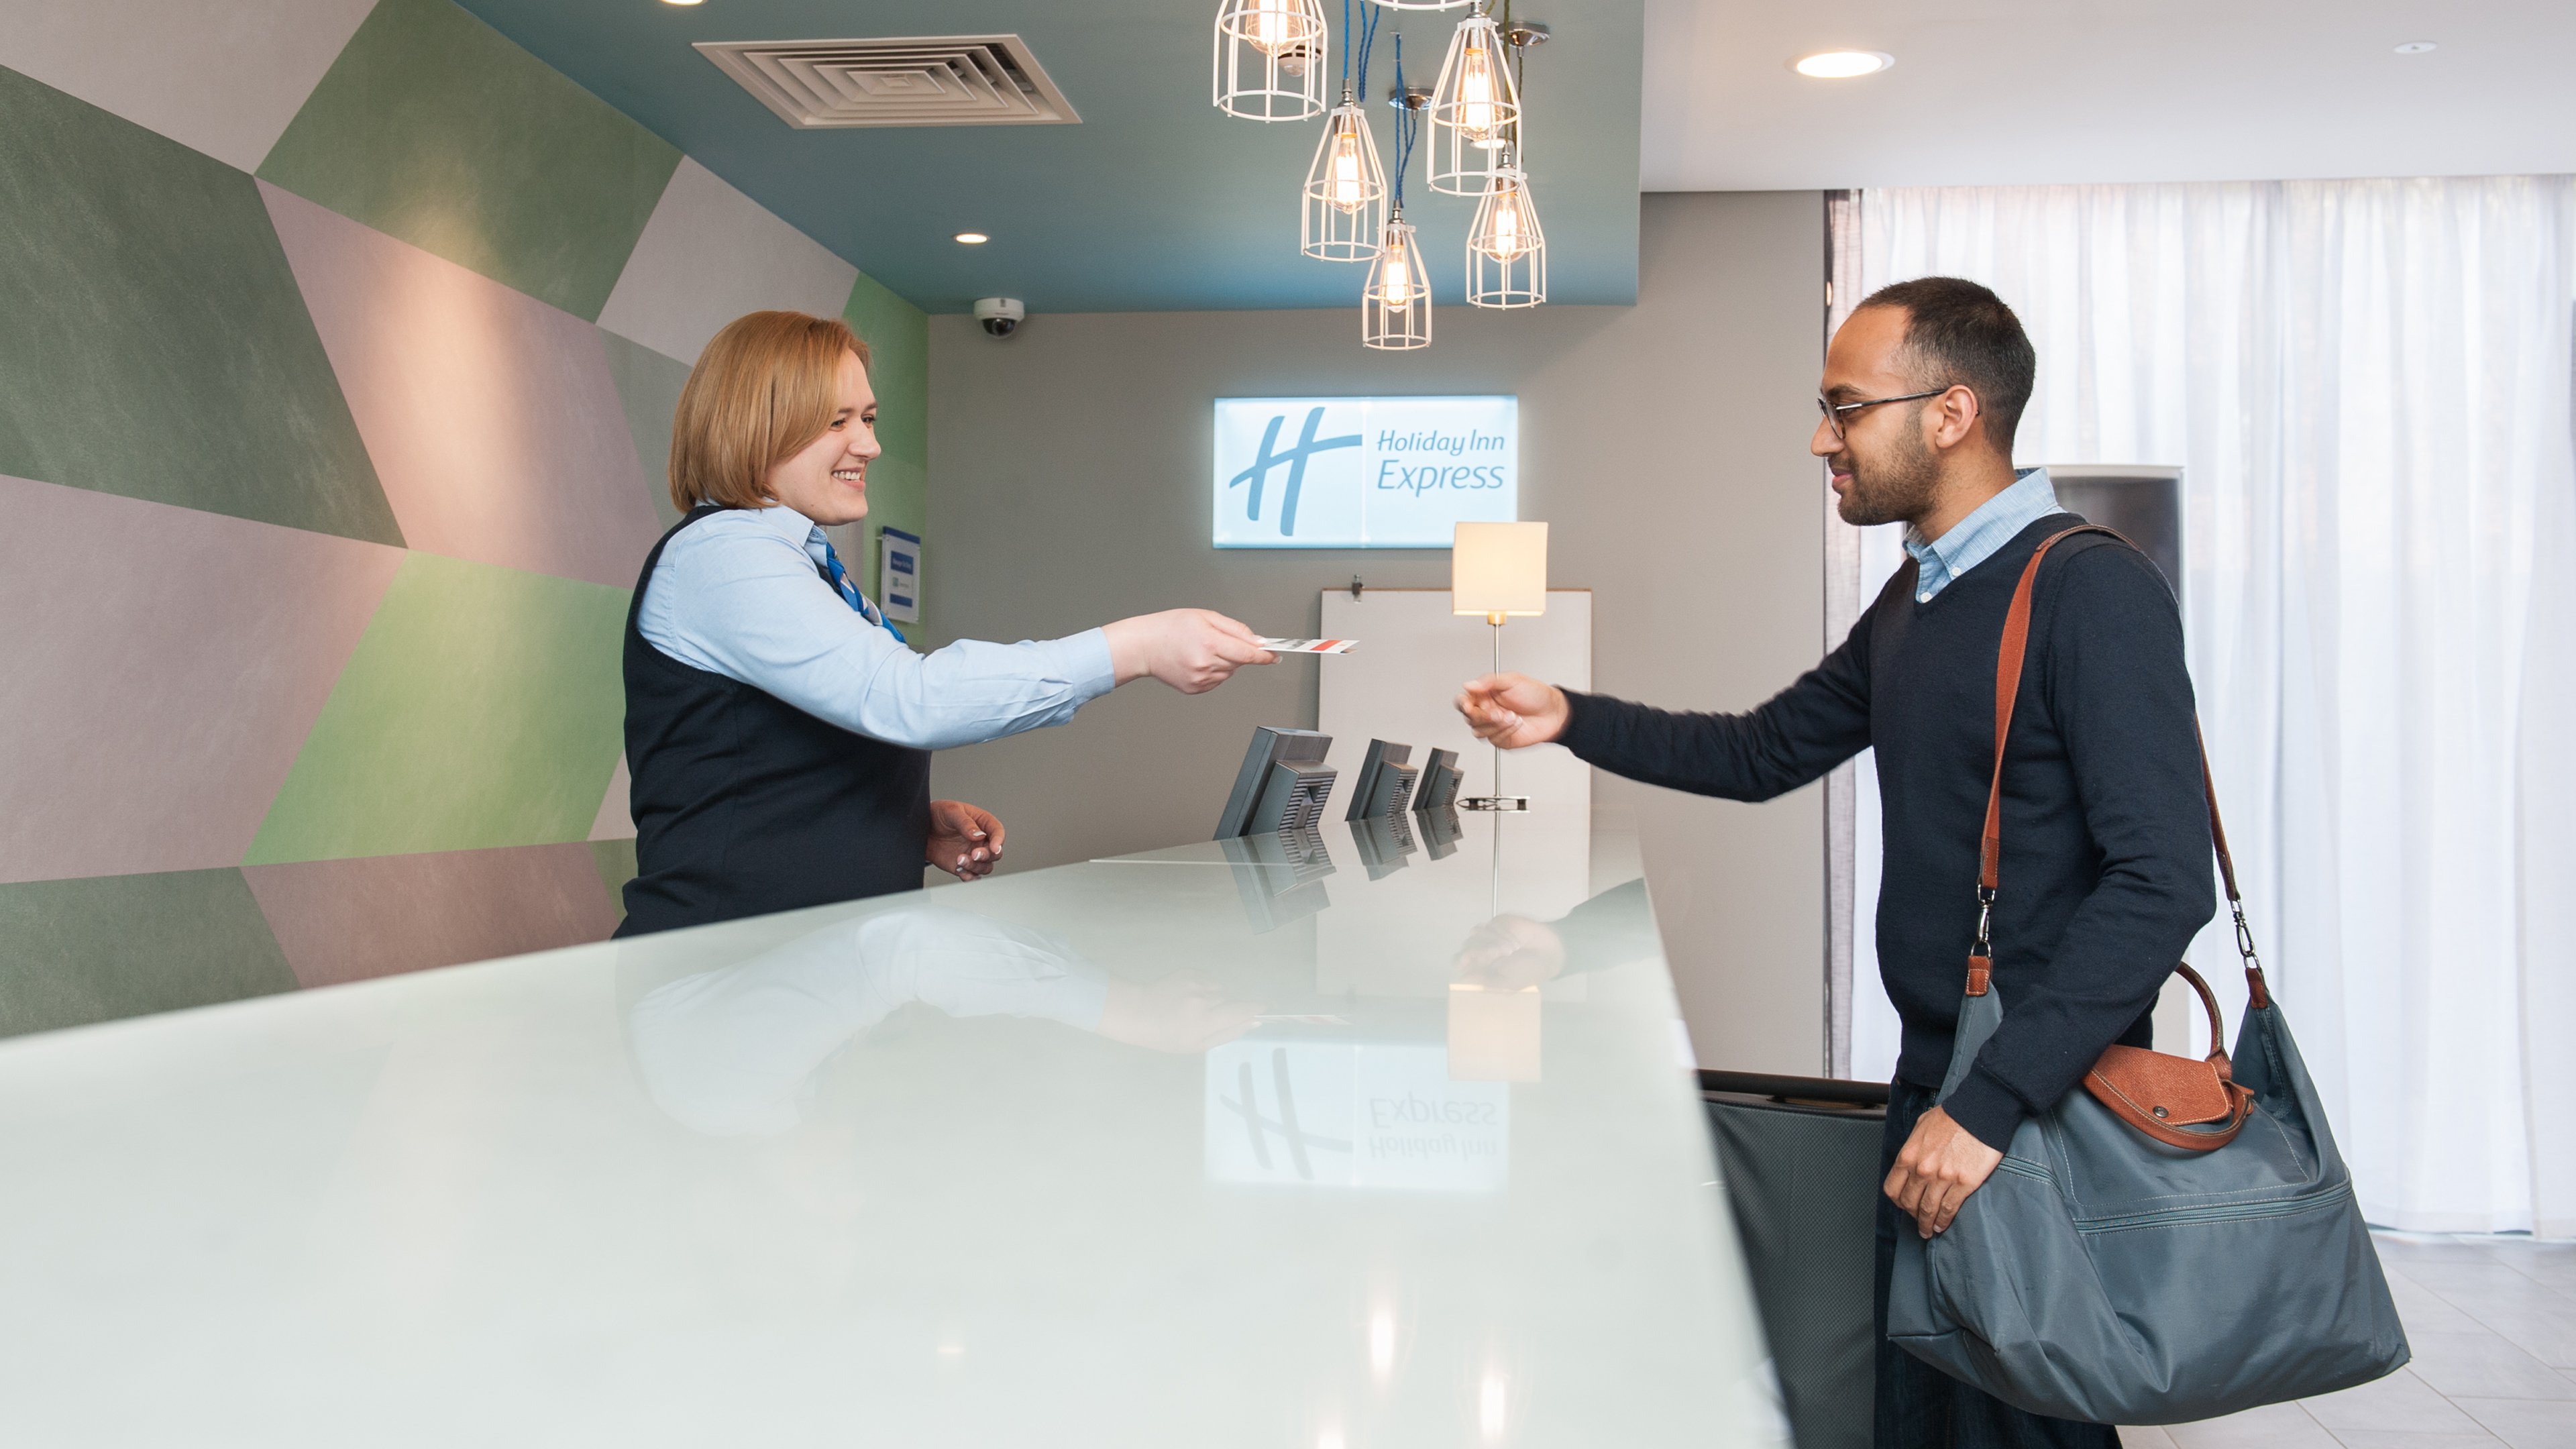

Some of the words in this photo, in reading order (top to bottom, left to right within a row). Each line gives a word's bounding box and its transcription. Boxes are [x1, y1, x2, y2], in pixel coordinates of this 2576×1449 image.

[1377, 430, 1466, 456] Holiday
[1470, 429, 1505, 450] Inn
[1378, 460, 1505, 497] Express
